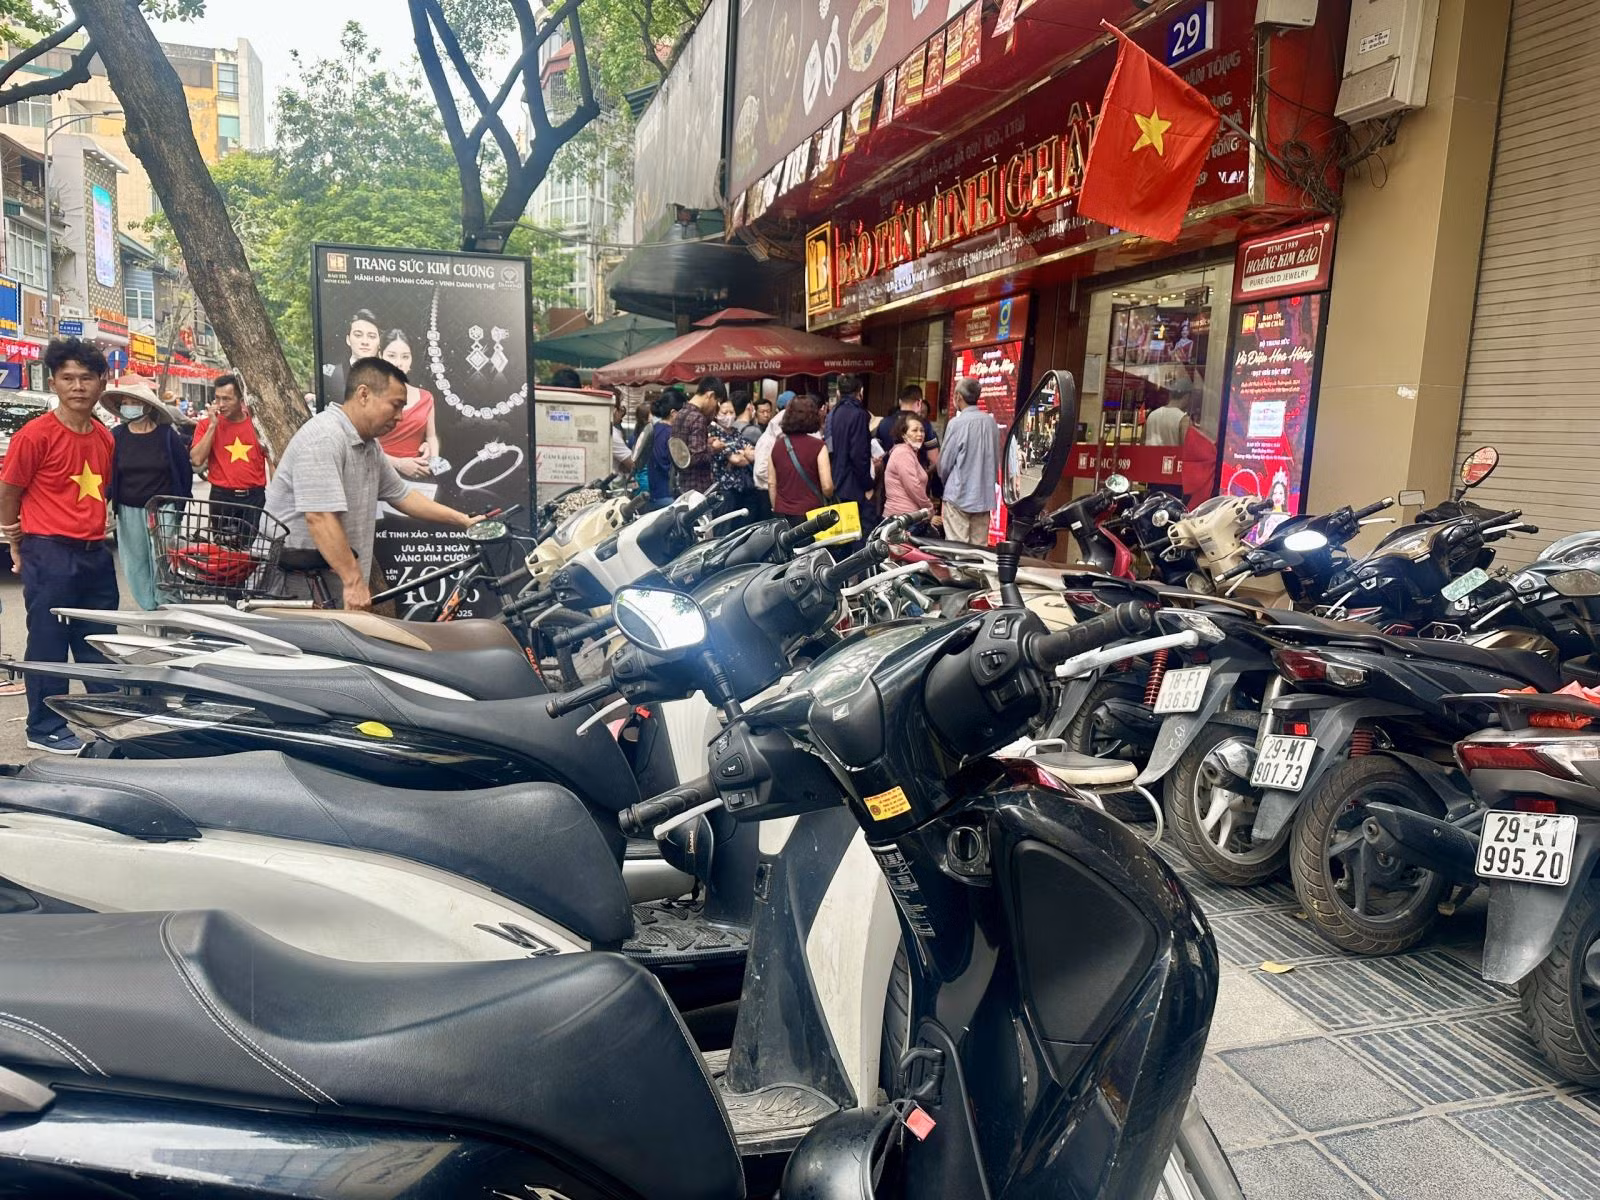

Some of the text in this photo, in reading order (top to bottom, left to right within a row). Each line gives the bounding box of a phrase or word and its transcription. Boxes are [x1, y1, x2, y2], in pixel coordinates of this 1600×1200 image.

[1172, 14, 1200, 57] 29
[837, 219, 873, 287] BẢO
[873, 200, 914, 270] TÍN
[915, 163, 999, 258] MINH
[1004, 101, 1101, 218] CHÂ
[1284, 240, 1298, 250] 1989
[354, 256, 495, 278] TRANG SỨC KIM CƯƠNG
[1246, 244, 1318, 274] HOÀNG KIM BẢO
[354, 273, 374, 282] HÃNH
[375, 274, 391, 284] DIỆN
[392, 276, 414, 285] THÀNH
[415, 276, 434, 286] CÔNG
[439, 280, 455, 288] VINH
[456, 281, 475, 289] DANH
[1250, 270, 1309, 287] PURE GOLD JEWELRY
[1268, 348, 1287, 363] Hoa
[695, 360, 781, 373] 29 TRẦN NHÂN TÔNG
[411, 530, 428, 538] XẢO
[450, 532, 468, 540] DẠN
[417, 544, 435, 552] ĐÃI
[444, 544, 470, 552] NGÀY
[394, 554, 421, 562] VÀNG
[1264, 738, 1306, 761] 29-M1
[1254, 762, 1303, 786] 901.73
[1494, 816, 1560, 847] 29-K1
[1483, 846, 1564, 879] 995.20
